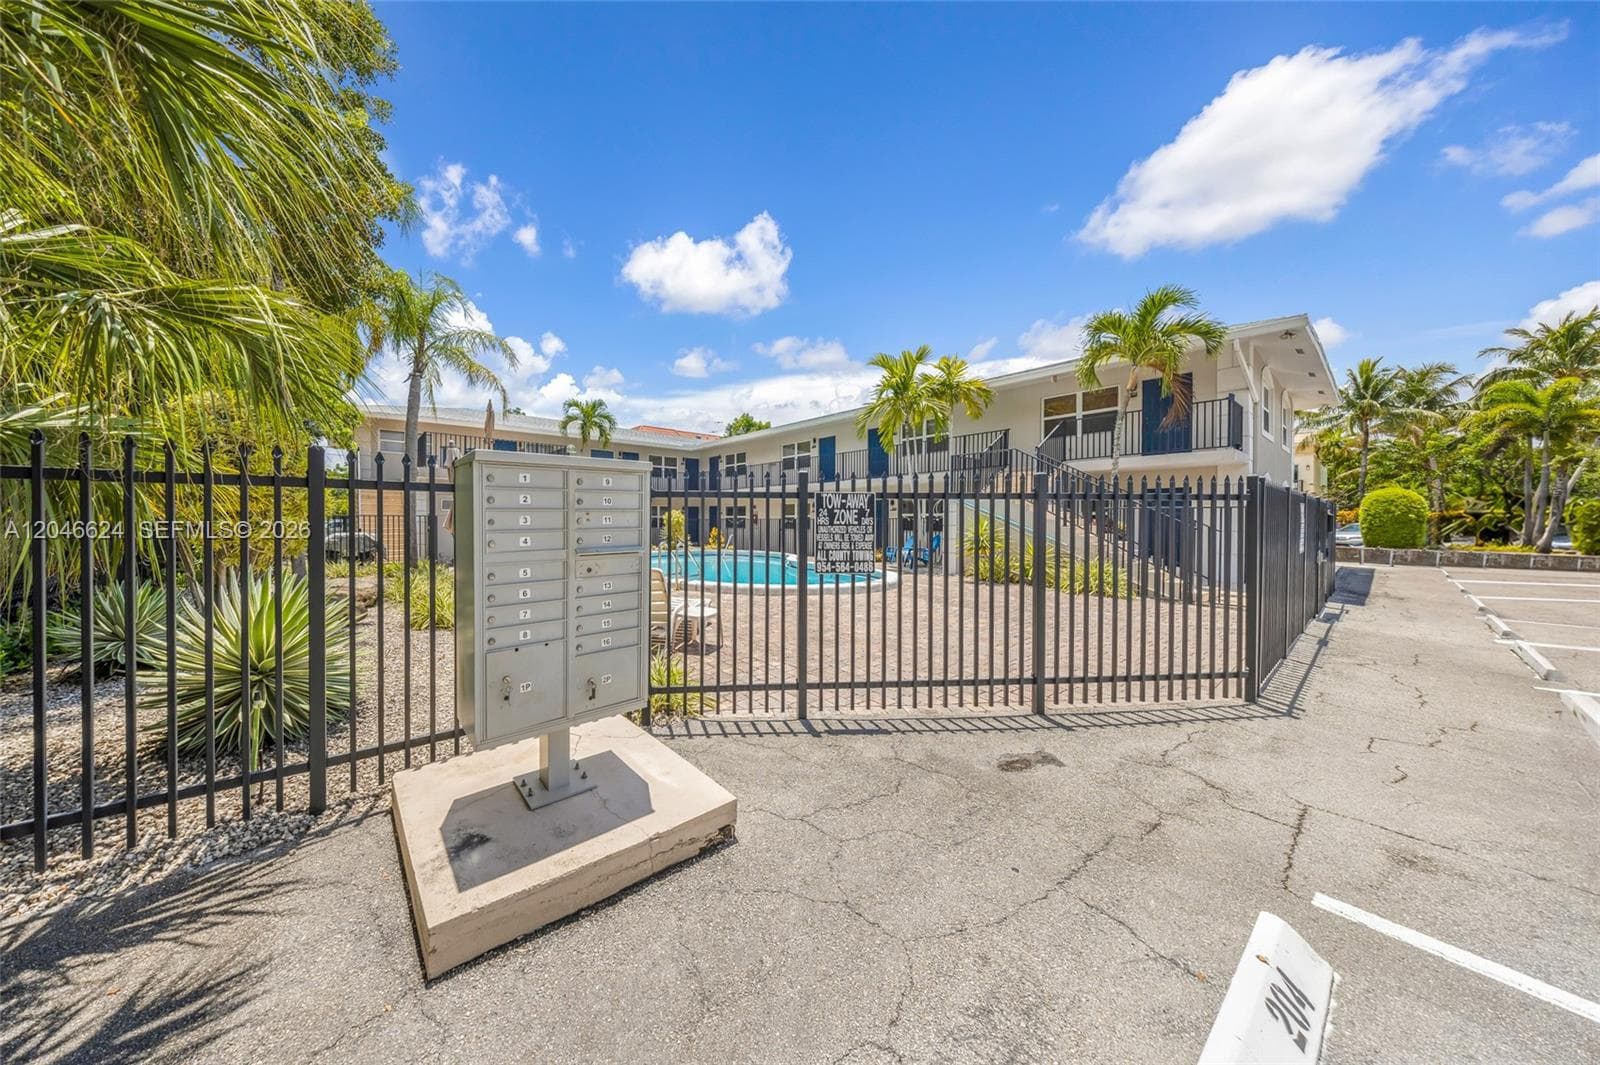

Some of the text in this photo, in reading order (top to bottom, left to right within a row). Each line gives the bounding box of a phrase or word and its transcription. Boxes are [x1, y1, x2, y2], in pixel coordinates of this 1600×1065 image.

[822, 494, 871, 508] TOW-AWAY
[819, 508, 828, 516] 24
[834, 509, 858, 524] ZONE
[865, 508, 870, 517] 7
[817, 517, 829, 525] HRS
[861, 517, 873, 525] DAYS
[817, 550, 873, 561] ALL COUNTY TOWING
[521, 683, 530, 692] 1P
[1264, 966, 1315, 1054] 204
